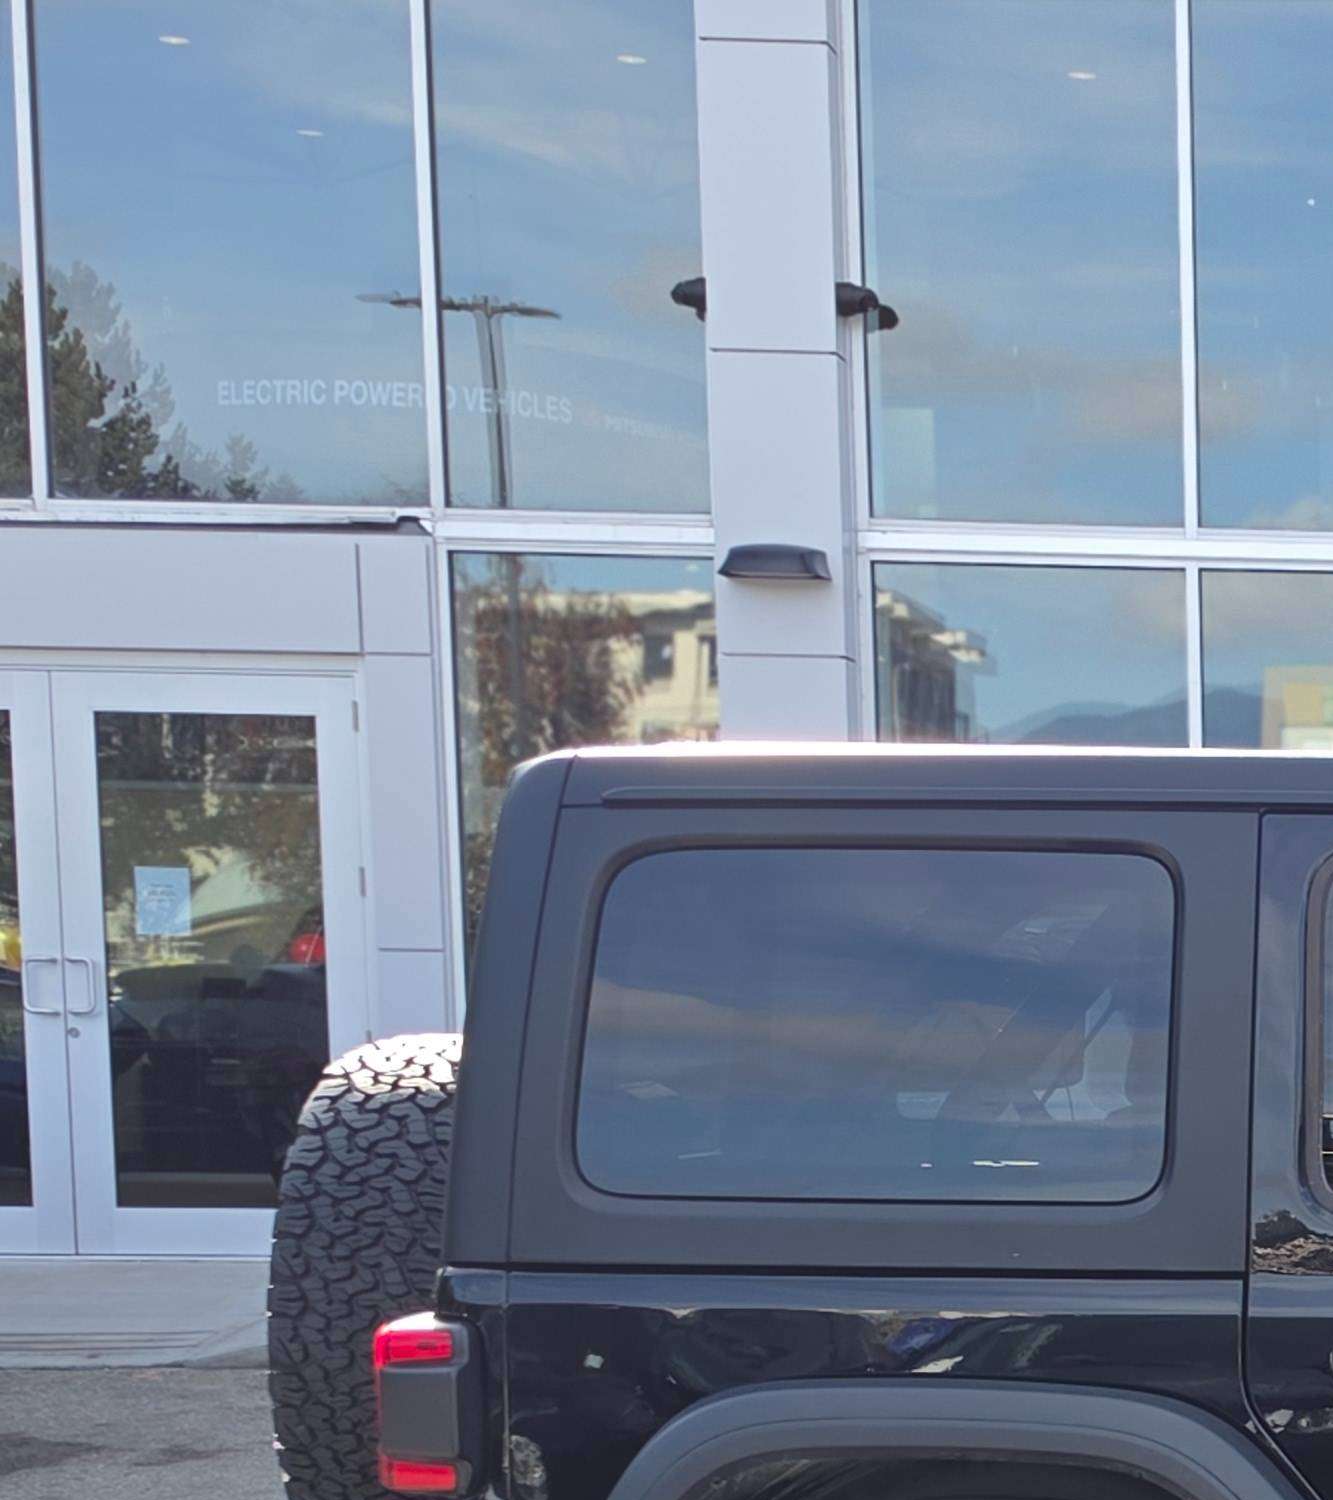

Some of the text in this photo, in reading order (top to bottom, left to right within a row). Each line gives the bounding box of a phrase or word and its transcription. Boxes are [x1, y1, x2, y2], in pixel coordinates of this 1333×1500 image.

[217, 379, 573, 424] ELECTRIC POWERD VEICLES
